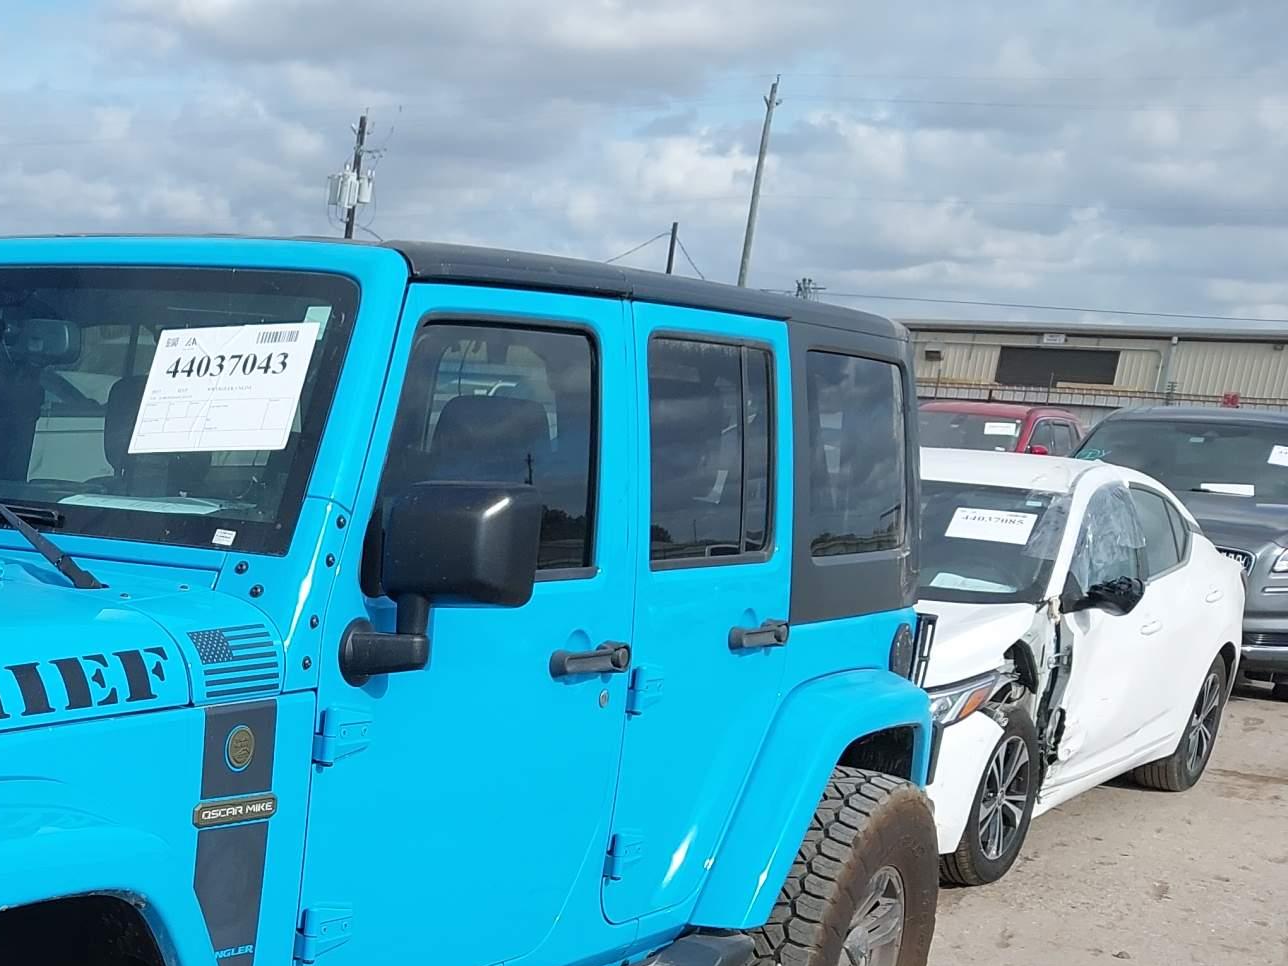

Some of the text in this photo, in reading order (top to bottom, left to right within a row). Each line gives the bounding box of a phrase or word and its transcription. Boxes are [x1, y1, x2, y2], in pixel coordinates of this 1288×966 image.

[165, 352, 289, 378] 44037043
[201, 801, 273, 820] OSCAR MIKE
